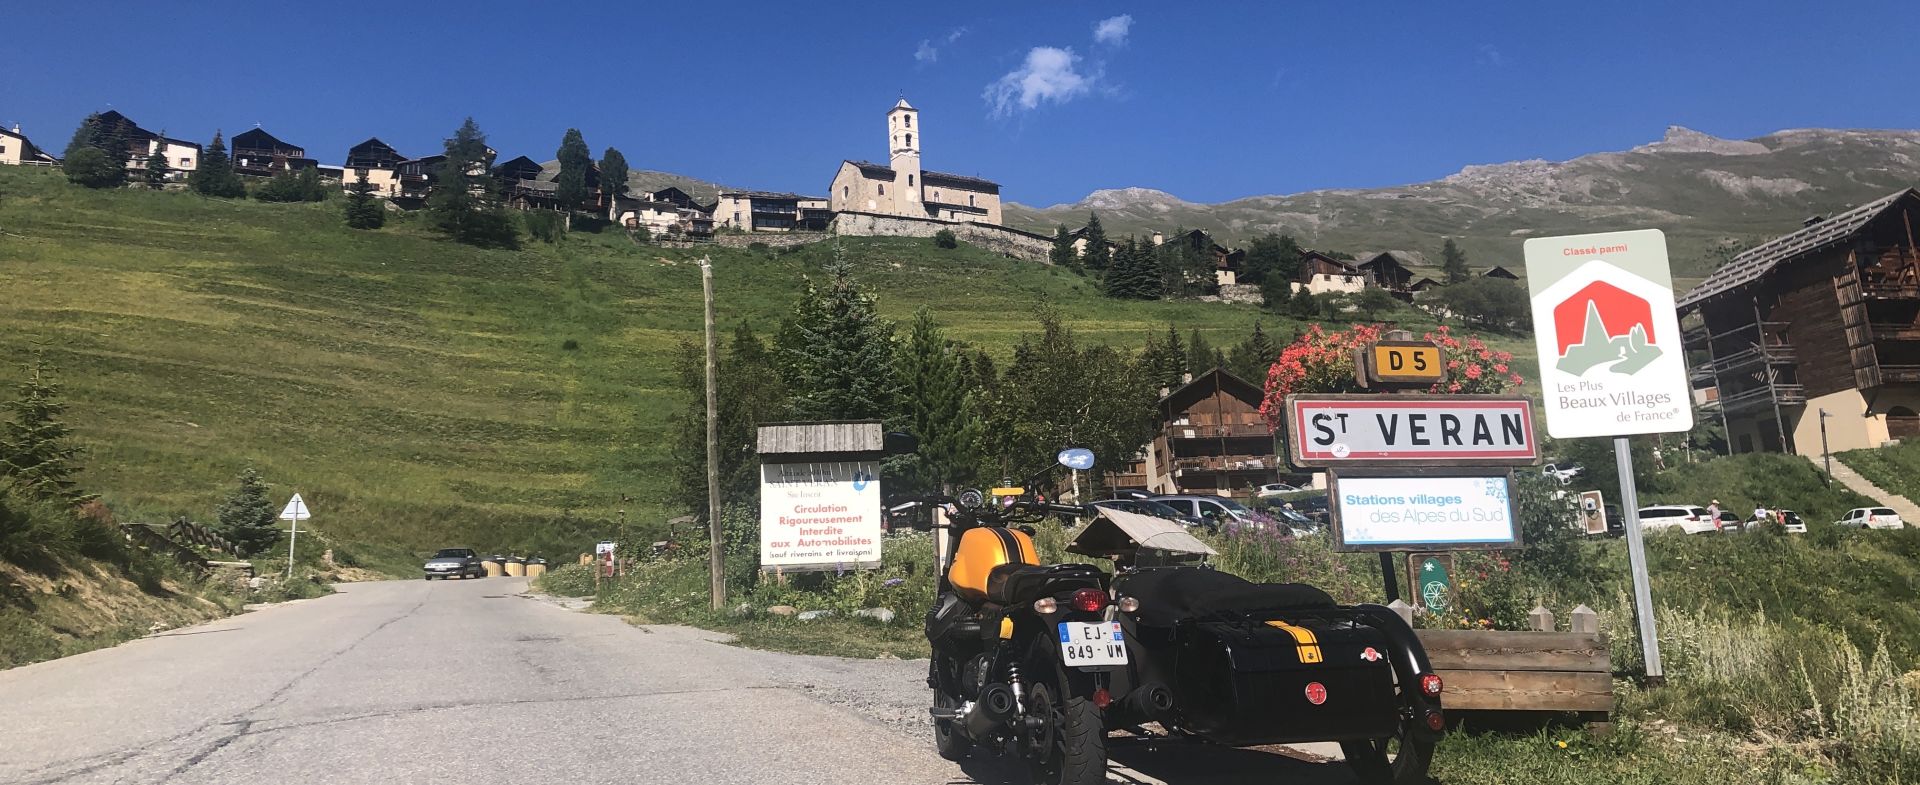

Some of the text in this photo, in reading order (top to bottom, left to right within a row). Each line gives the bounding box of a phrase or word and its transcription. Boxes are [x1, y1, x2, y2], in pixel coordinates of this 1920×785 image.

[1563, 244, 1628, 257] Classé parmi
[1389, 350, 1427, 371] D 5
[1557, 380, 1604, 393] Les Plus
[1559, 391, 1671, 410] Beaux Villages
[1616, 411, 1631, 422] de
[1376, 413, 1525, 446] VERAN
[1345, 493, 1463, 509] Stations villages
[794, 504, 848, 514] Circulation
[779, 515, 863, 527] Rigoureusement
[1370, 508, 1504, 525] des Alpes du Sud
[799, 526, 844, 536] Interdite
[797, 536, 872, 547] Automobilistes
[790, 550, 823, 558] riverains
